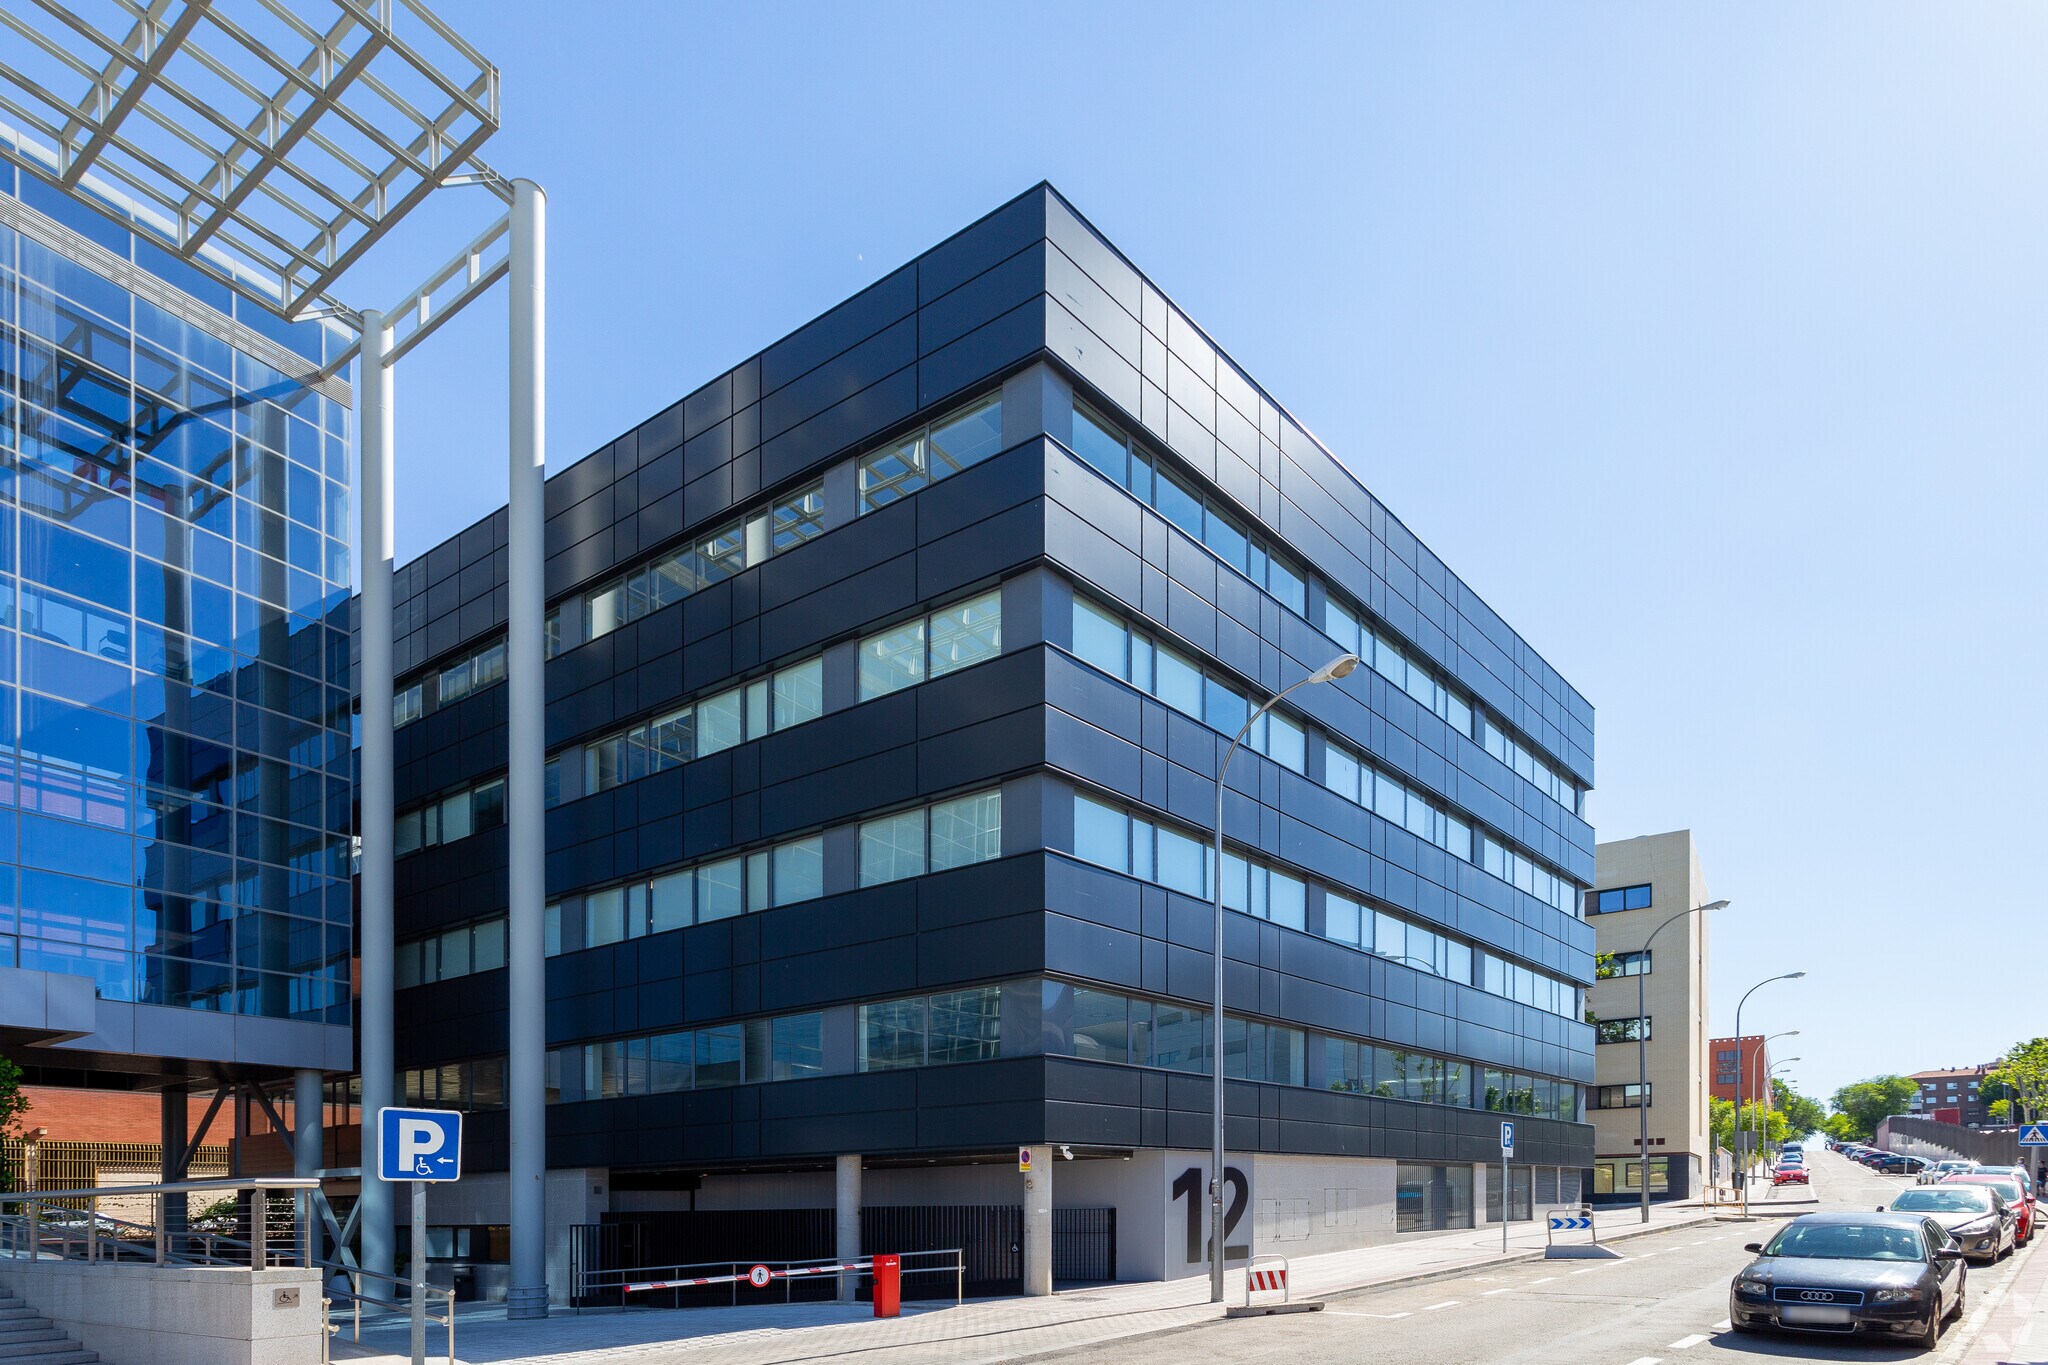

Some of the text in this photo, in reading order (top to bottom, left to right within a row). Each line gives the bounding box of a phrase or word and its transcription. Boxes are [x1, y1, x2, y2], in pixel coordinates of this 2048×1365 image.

[399, 1118, 445, 1171] P
[1504, 1125, 1511, 1145] P
[1173, 1167, 1249, 1263] 12
